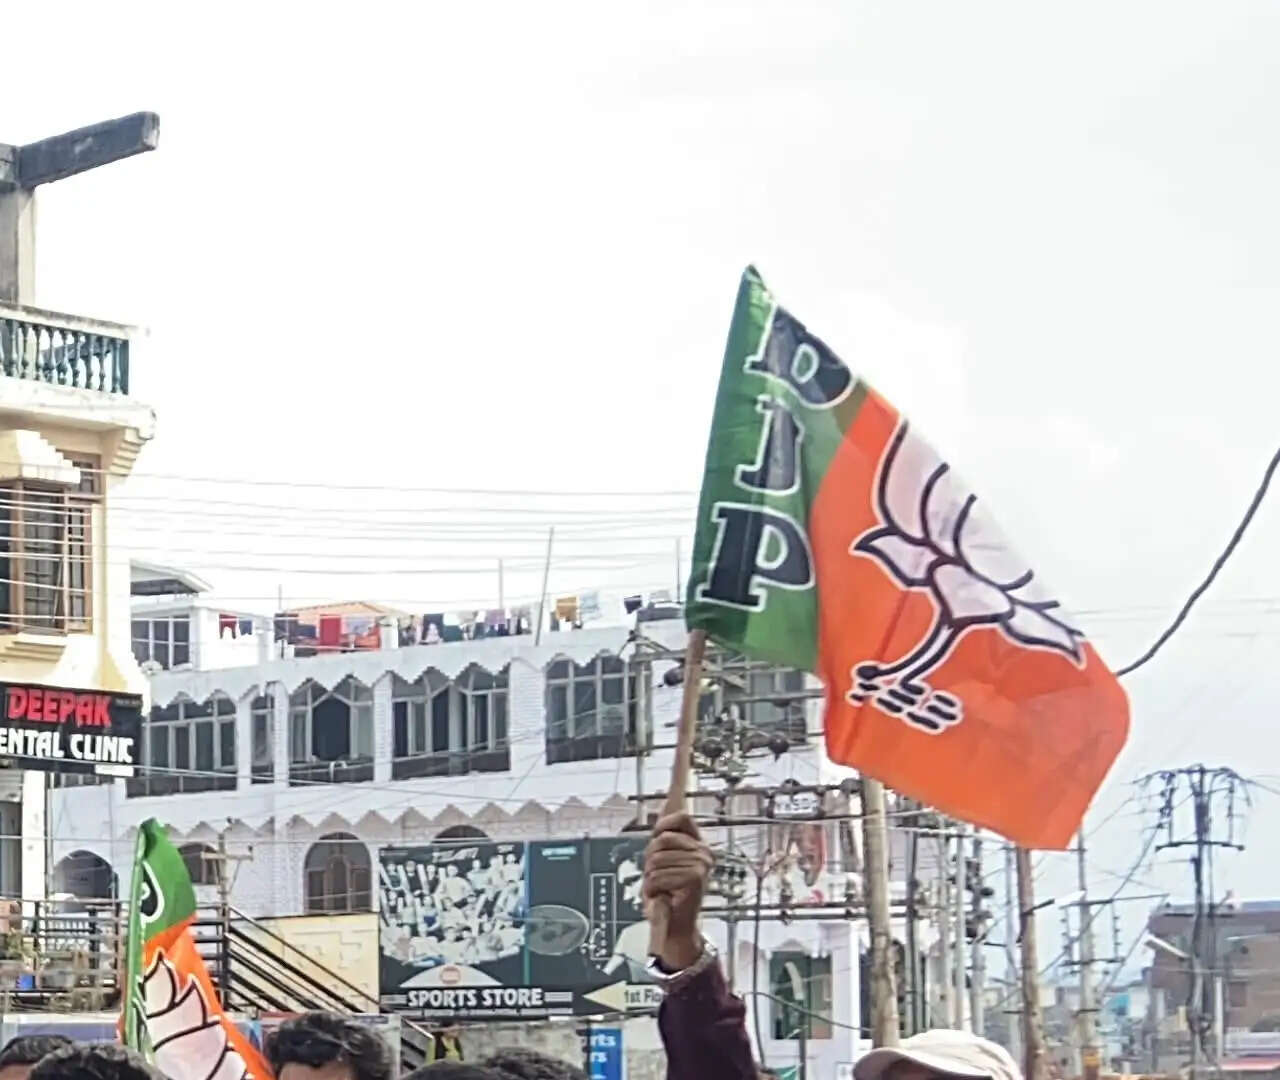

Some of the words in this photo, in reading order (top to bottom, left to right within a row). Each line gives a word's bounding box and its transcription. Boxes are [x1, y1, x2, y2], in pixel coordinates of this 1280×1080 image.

[6, 686, 112, 729] DEEPAK
[407, 990, 477, 1008] SPORTS
[482, 988, 544, 1006] STORE
